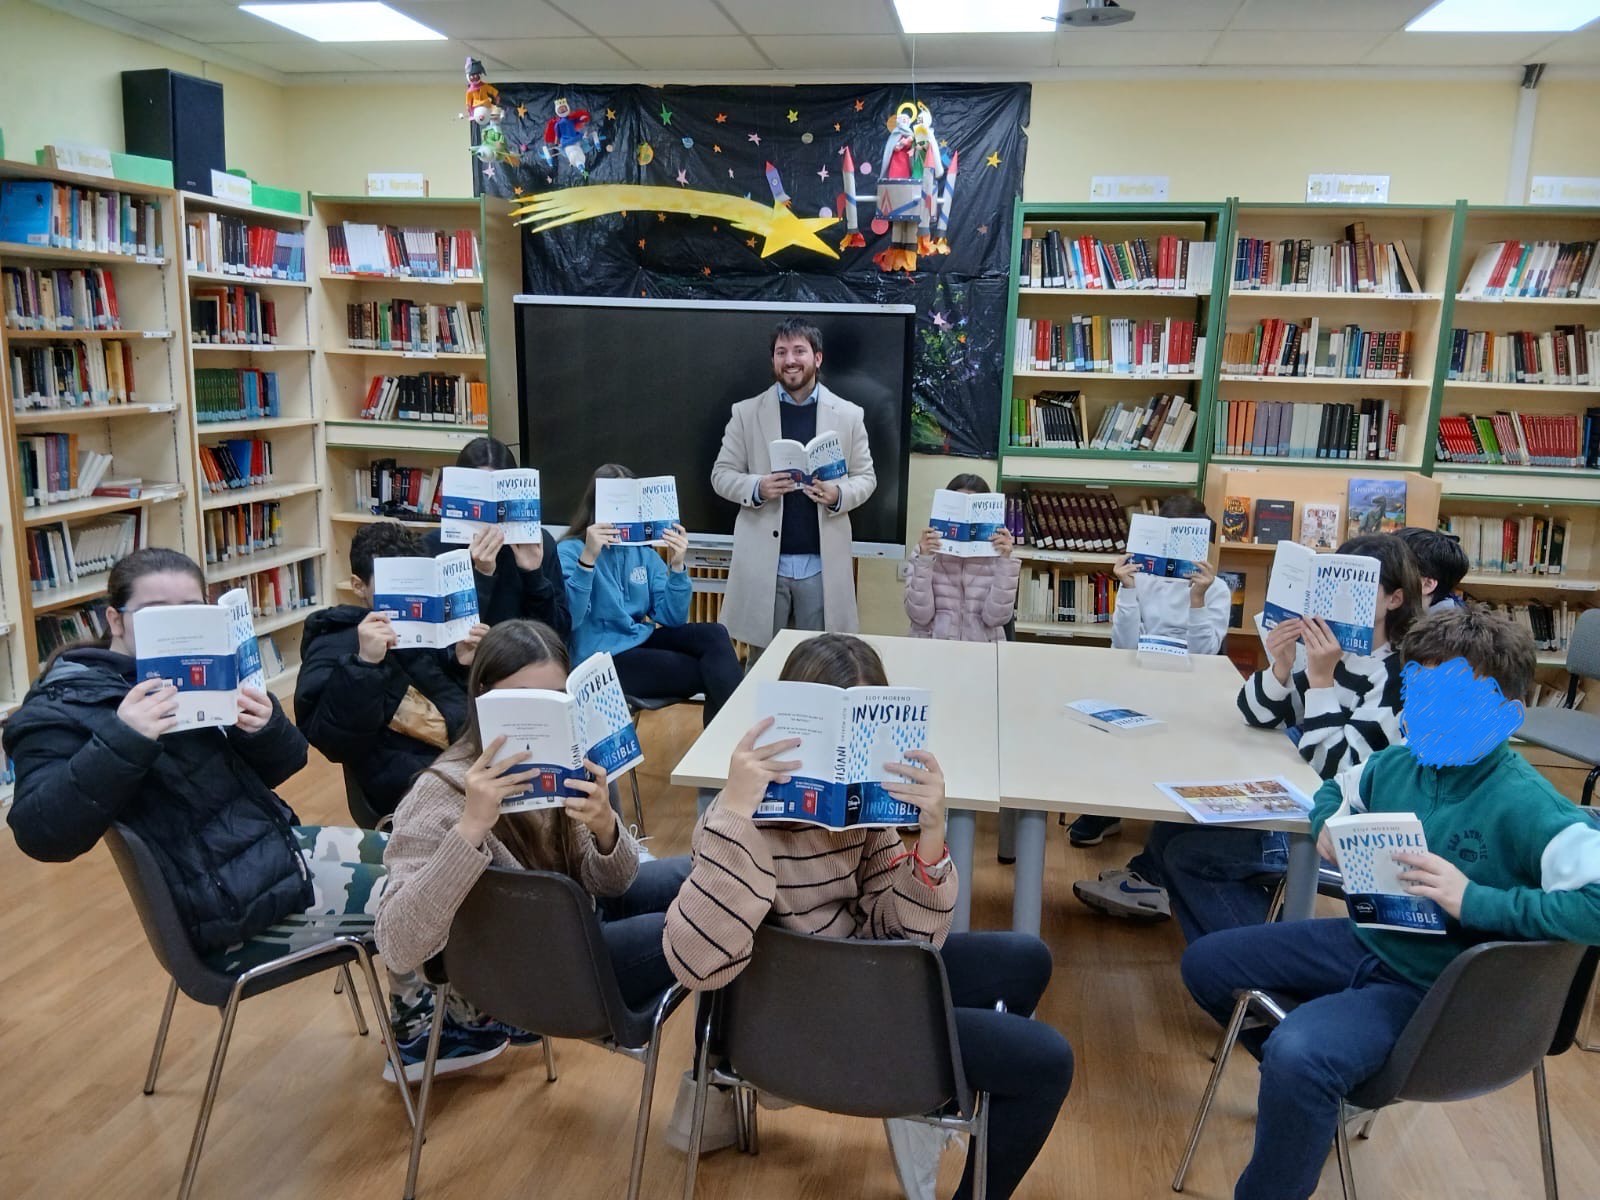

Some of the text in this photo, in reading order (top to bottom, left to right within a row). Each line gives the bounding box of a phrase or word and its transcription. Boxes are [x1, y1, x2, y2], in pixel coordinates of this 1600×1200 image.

[497, 478, 536, 489] INVISIBLE
[1316, 565, 1377, 583] INVISIBLE
[576, 666, 616, 706] VISIBLE
[852, 703, 929, 724] INVISIBLE
[865, 800, 920, 816] INVISIBLE
[1338, 833, 1424, 851] INVISIBLE
[1383, 908, 1439, 924] INVISIBLE
